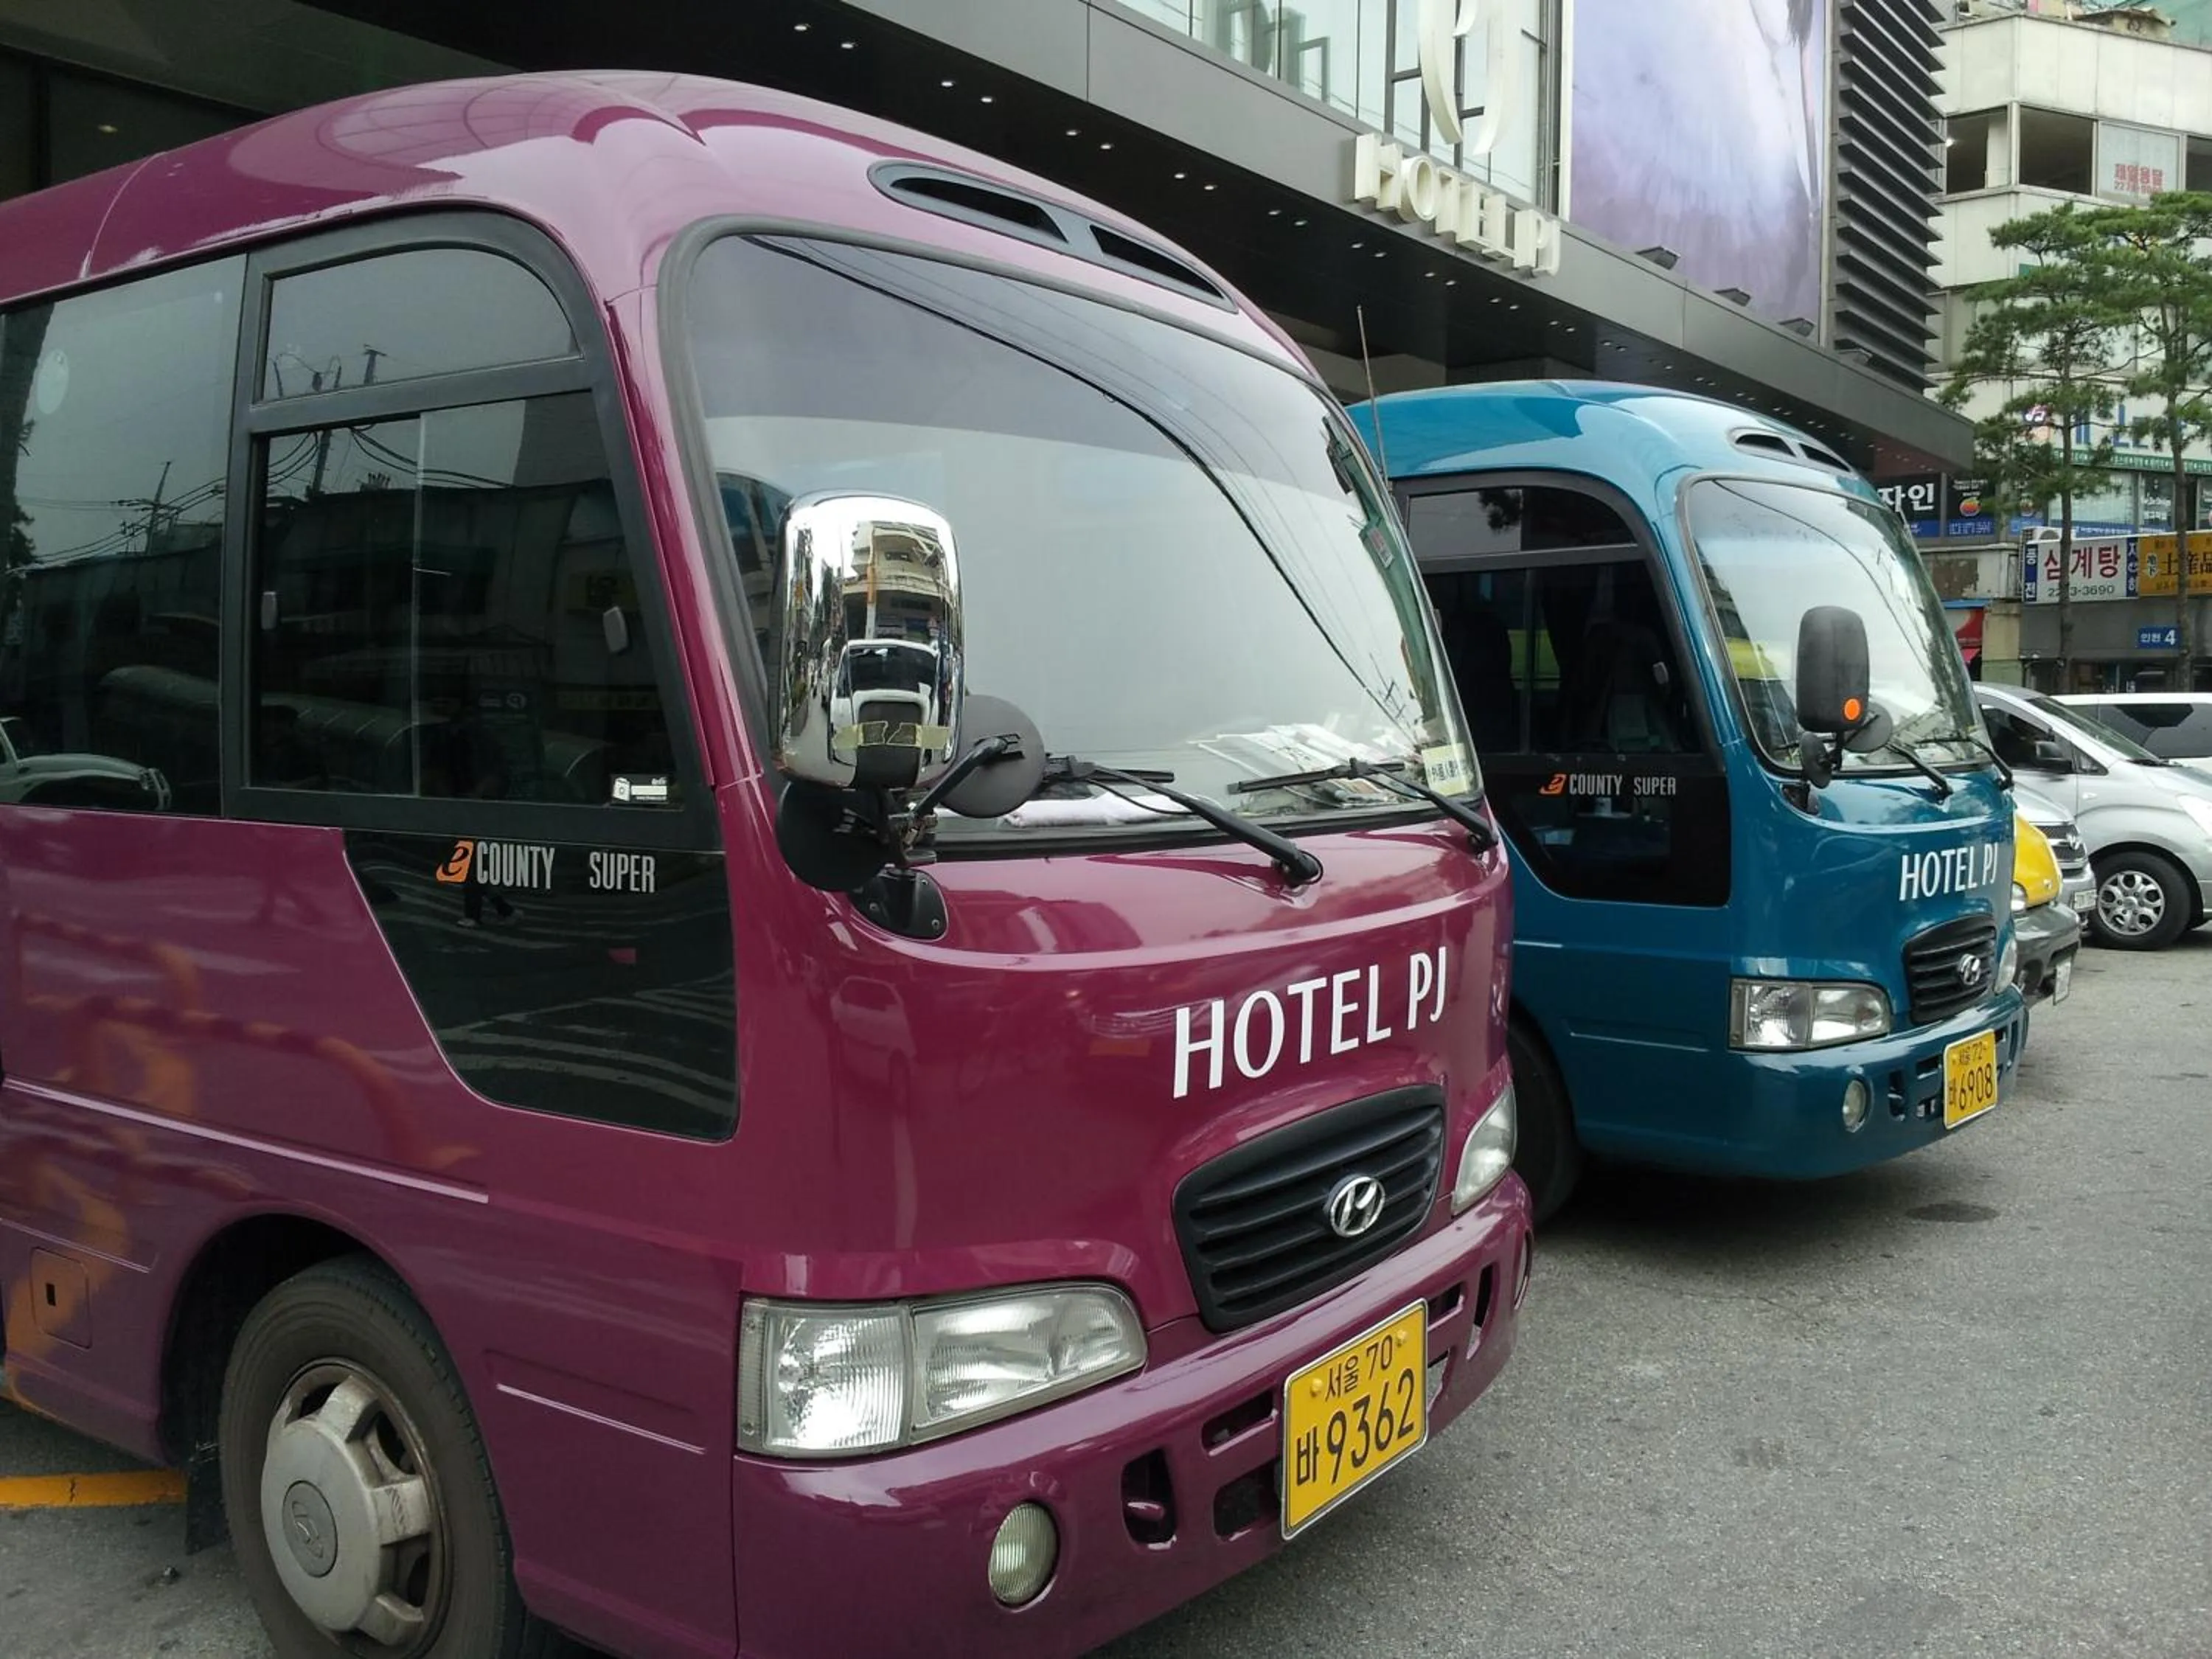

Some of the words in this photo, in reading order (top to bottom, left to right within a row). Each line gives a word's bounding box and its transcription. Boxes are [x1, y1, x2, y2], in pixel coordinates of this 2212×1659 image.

[1354, 133, 1515, 261] HOTEL
[1514, 209, 1561, 276] PJ
[1877, 482, 1935, 512] 자인
[2044, 544, 2121, 581] 삼계탕
[2165, 629, 2176, 646] 4
[1568, 773, 1623, 796] COUNTY
[1633, 776, 1677, 796] SUPER
[476, 841, 554, 890] COUNTY
[589, 852, 655, 893] SUPER
[1899, 846, 1978, 901] HOTEL
[1981, 841, 1999, 886] PJ
[1173, 964, 1391, 1099] HOTEL
[1408, 947, 1447, 1030] PJ
[1325, 1355, 1358, 1402] 서울
[1366, 1335, 1392, 1380] 70
[1296, 1368, 1415, 1486] 바9362
